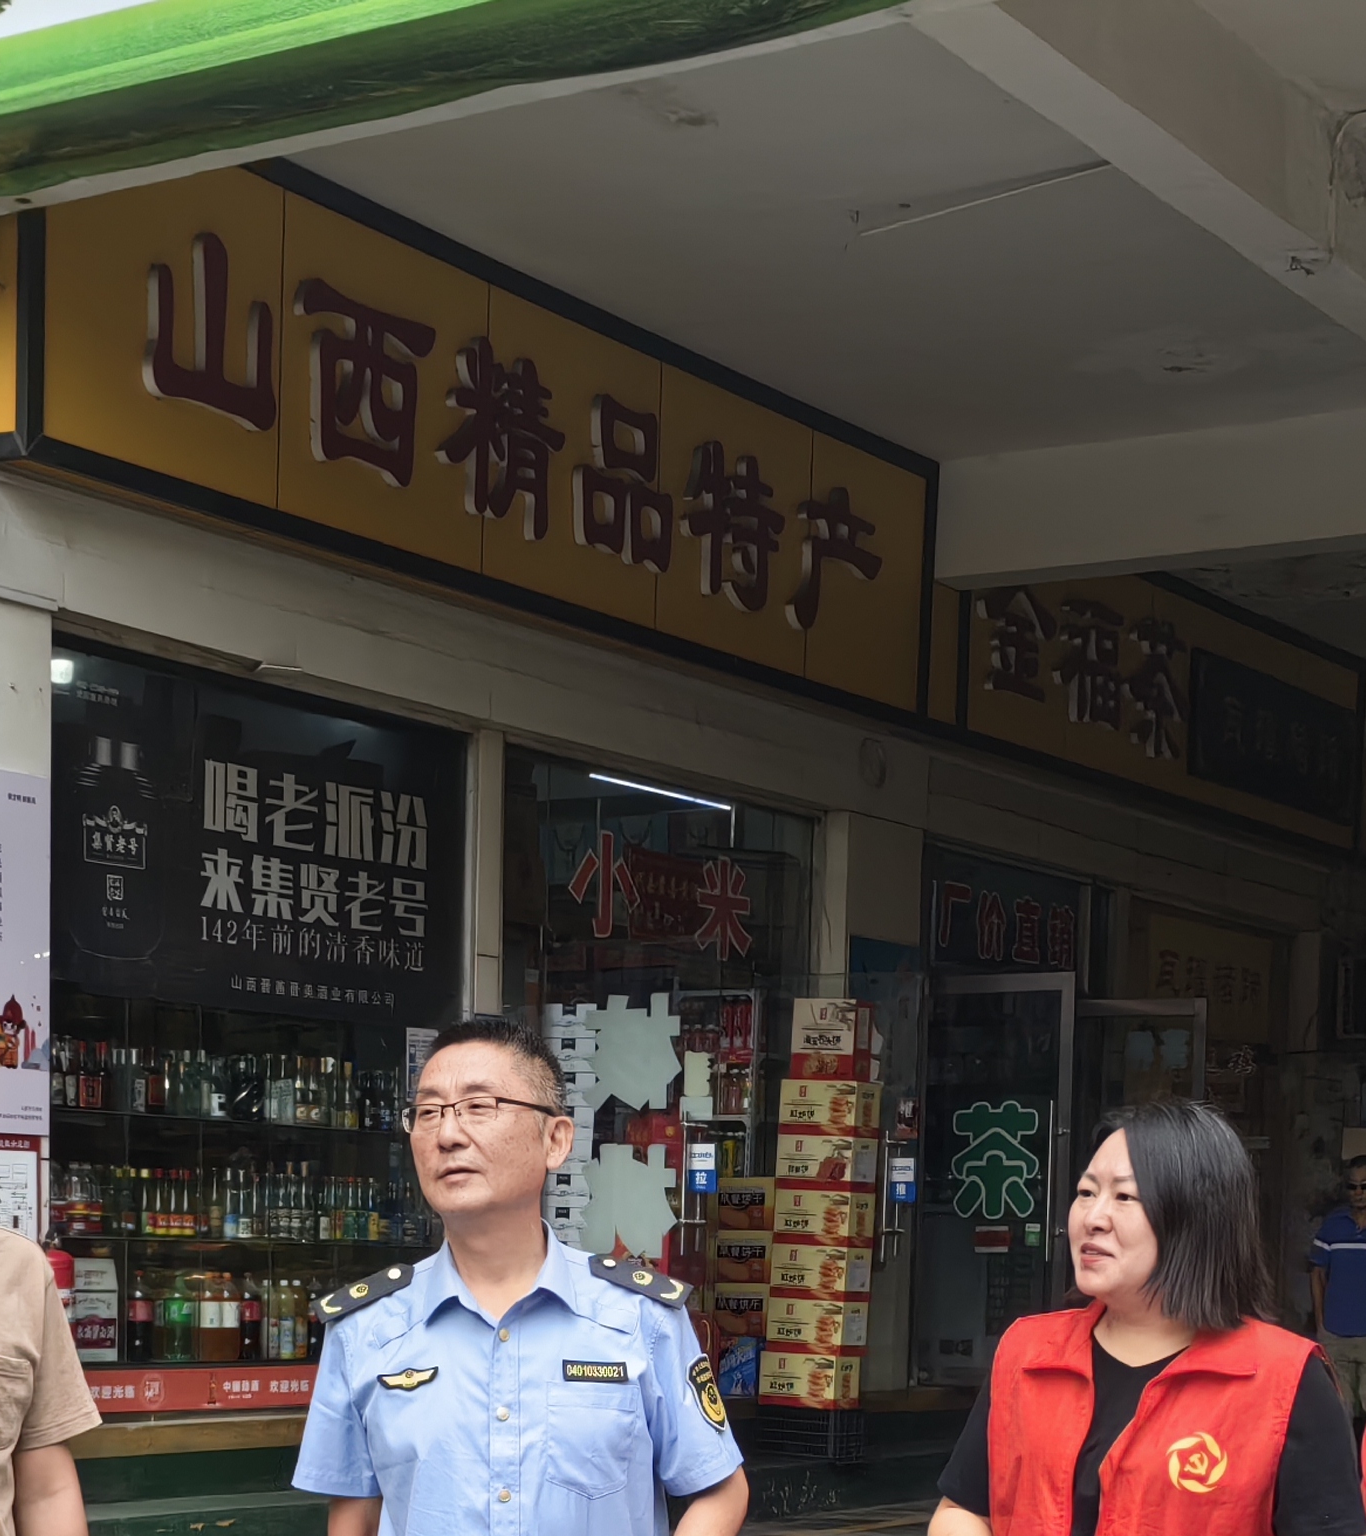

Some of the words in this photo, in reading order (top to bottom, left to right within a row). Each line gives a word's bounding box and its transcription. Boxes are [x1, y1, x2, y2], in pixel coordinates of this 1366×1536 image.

[141, 231, 883, 634] 山西精品特产
[203, 758, 429, 871] 喝老派汾
[199, 847, 430, 938] 来集贤老号
[567, 828, 754, 963] 小米
[938, 879, 1079, 971] 厂价直销
[200, 915, 426, 973] 142年前的清香味道
[694, 1171, 707, 1185] 拉
[895, 1182, 906, 1196] 推
[952, 1100, 1040, 1220] 茶
